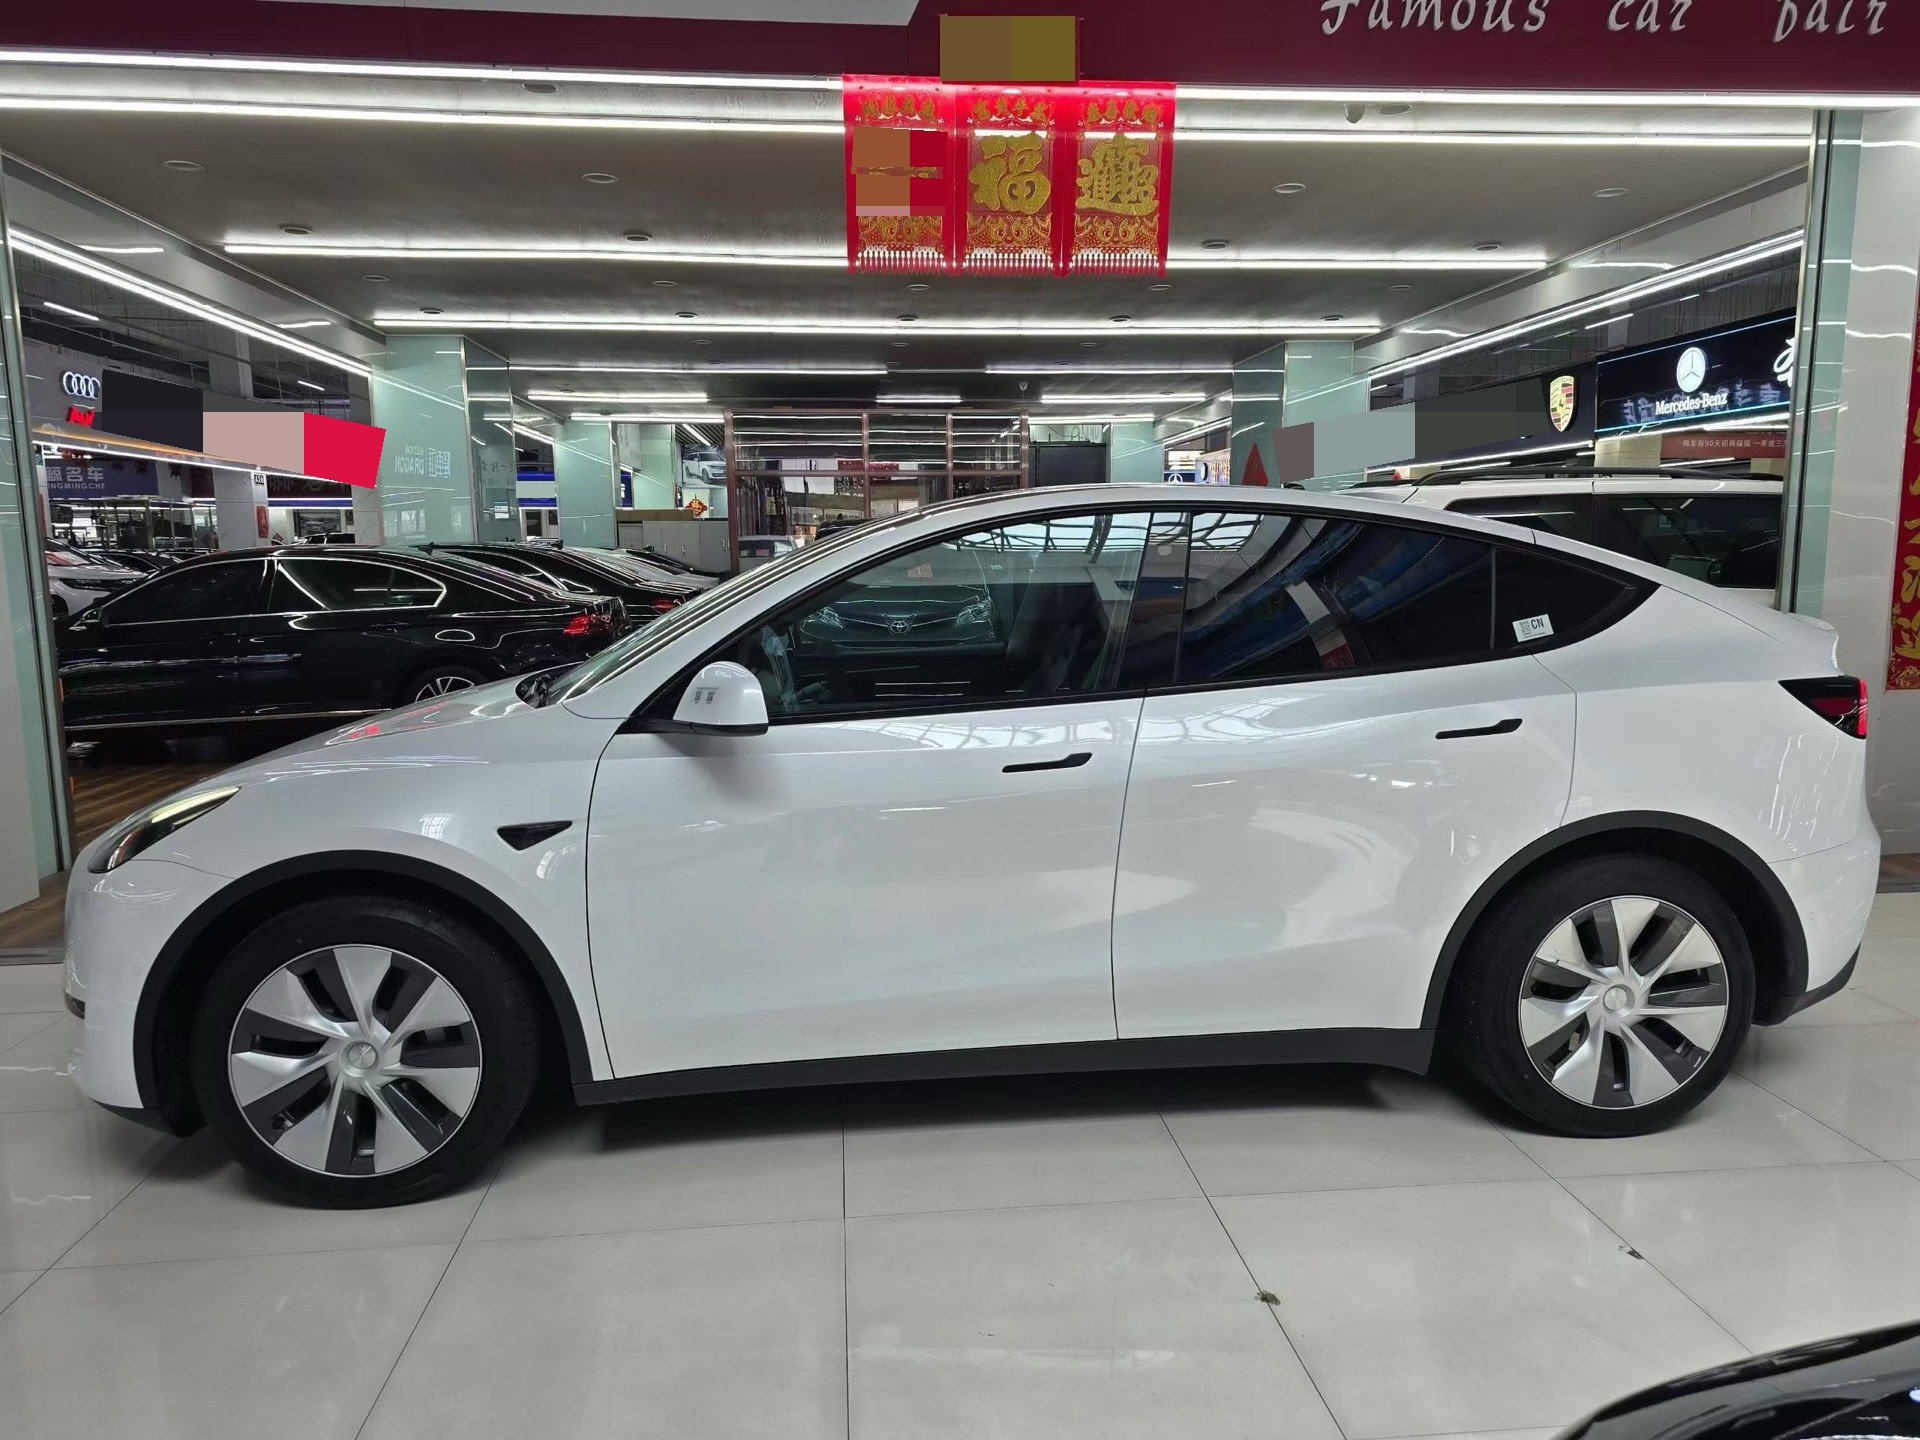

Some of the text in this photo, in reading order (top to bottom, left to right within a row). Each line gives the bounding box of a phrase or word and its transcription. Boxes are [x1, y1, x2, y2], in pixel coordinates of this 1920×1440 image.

[968, 131, 1051, 215] 福
[1655, 392, 1728, 416] Mercedes-Benz
[1530, 617, 1545, 630] CN
